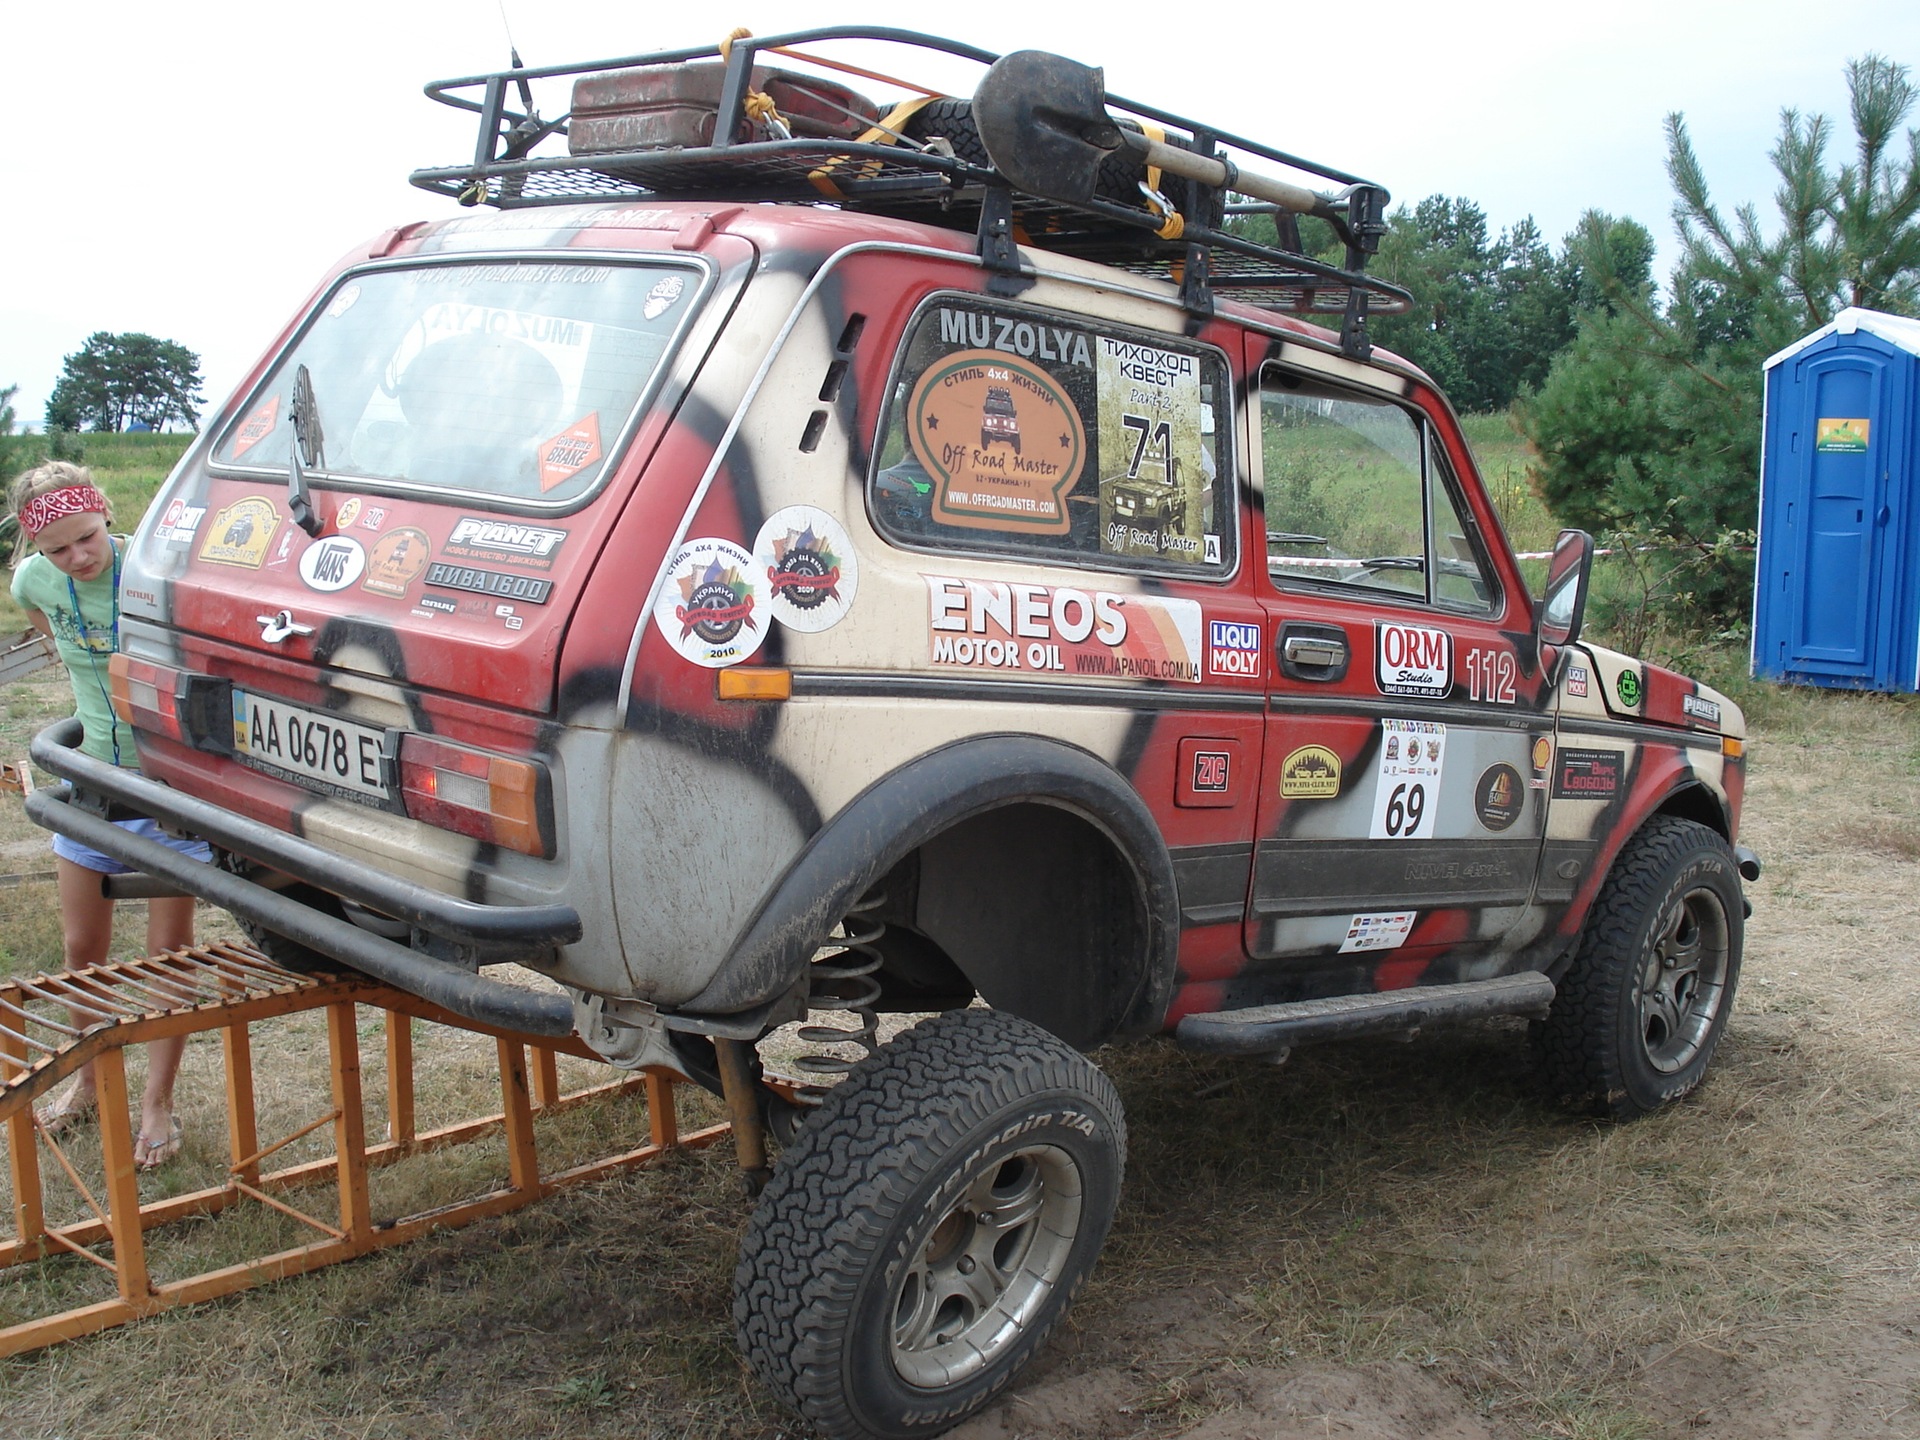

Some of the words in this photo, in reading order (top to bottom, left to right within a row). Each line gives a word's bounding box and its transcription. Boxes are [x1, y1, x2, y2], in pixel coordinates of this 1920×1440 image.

[940, 308, 1092, 369] MUZOLYA
[1104, 339, 1192, 376] ТИХОХОД
[944, 368, 985, 387] СТИЛЬ
[1011, 373, 1055, 406] ЖИЗНИ
[1120, 361, 1178, 388] КВЕСТ
[1130, 388, 1158, 408] Part
[545, 446, 589, 467] BRAKE
[943, 442, 967, 475] Off
[972, 449, 1007, 475] Road
[1013, 455, 1059, 475] Master
[1122, 413, 1173, 486] 71
[948, 490, 1055, 513] WWW.OFFROADMASTER.COM
[450, 517, 567, 556] PLANET
[1131, 529, 1158, 551] Road
[1161, 533, 1198, 551] Master
[312, 543, 354, 584] VANS
[446, 546, 469, 556] НОВОЕ
[470, 550, 507, 561] КАЧЕСТВО
[506, 555, 551, 568] ДВИЖЕНИЯ
[717, 543, 750, 567] ЖИЗНИ
[430, 564, 486, 590] НИВА
[488, 576, 544, 600] 1600
[692, 586, 735, 606] УКРАИНА
[931, 578, 1127, 647] ENEOS
[1213, 624, 1258, 651] LIQUI
[1385, 627, 1444, 671] ORM
[710, 646, 735, 658] 2010
[933, 635, 1021, 668] MOTOR
[1026, 642, 1065, 671] OIL
[1213, 650, 1259, 674] MOLY
[1075, 654, 1200, 681] WWW.JAPANOIL.COM.UA
[1396, 670, 1433, 683] Studio
[1466, 648, 1517, 704] 112
[1568, 668, 1585, 681] LIQUI
[1568, 681, 1586, 694] MOLY
[1684, 694, 1720, 722] PLANET
[235, 730, 246, 744] UA
[251, 704, 282, 758] AA
[288, 716, 349, 777] 0678
[1198, 756, 1226, 785] ZIC
[1529, 779, 1548, 788] Shell
[1386, 783, 1425, 837] 69
[1404, 862, 1460, 880] NIVA
[1058, 1110, 1097, 1138] T/A
